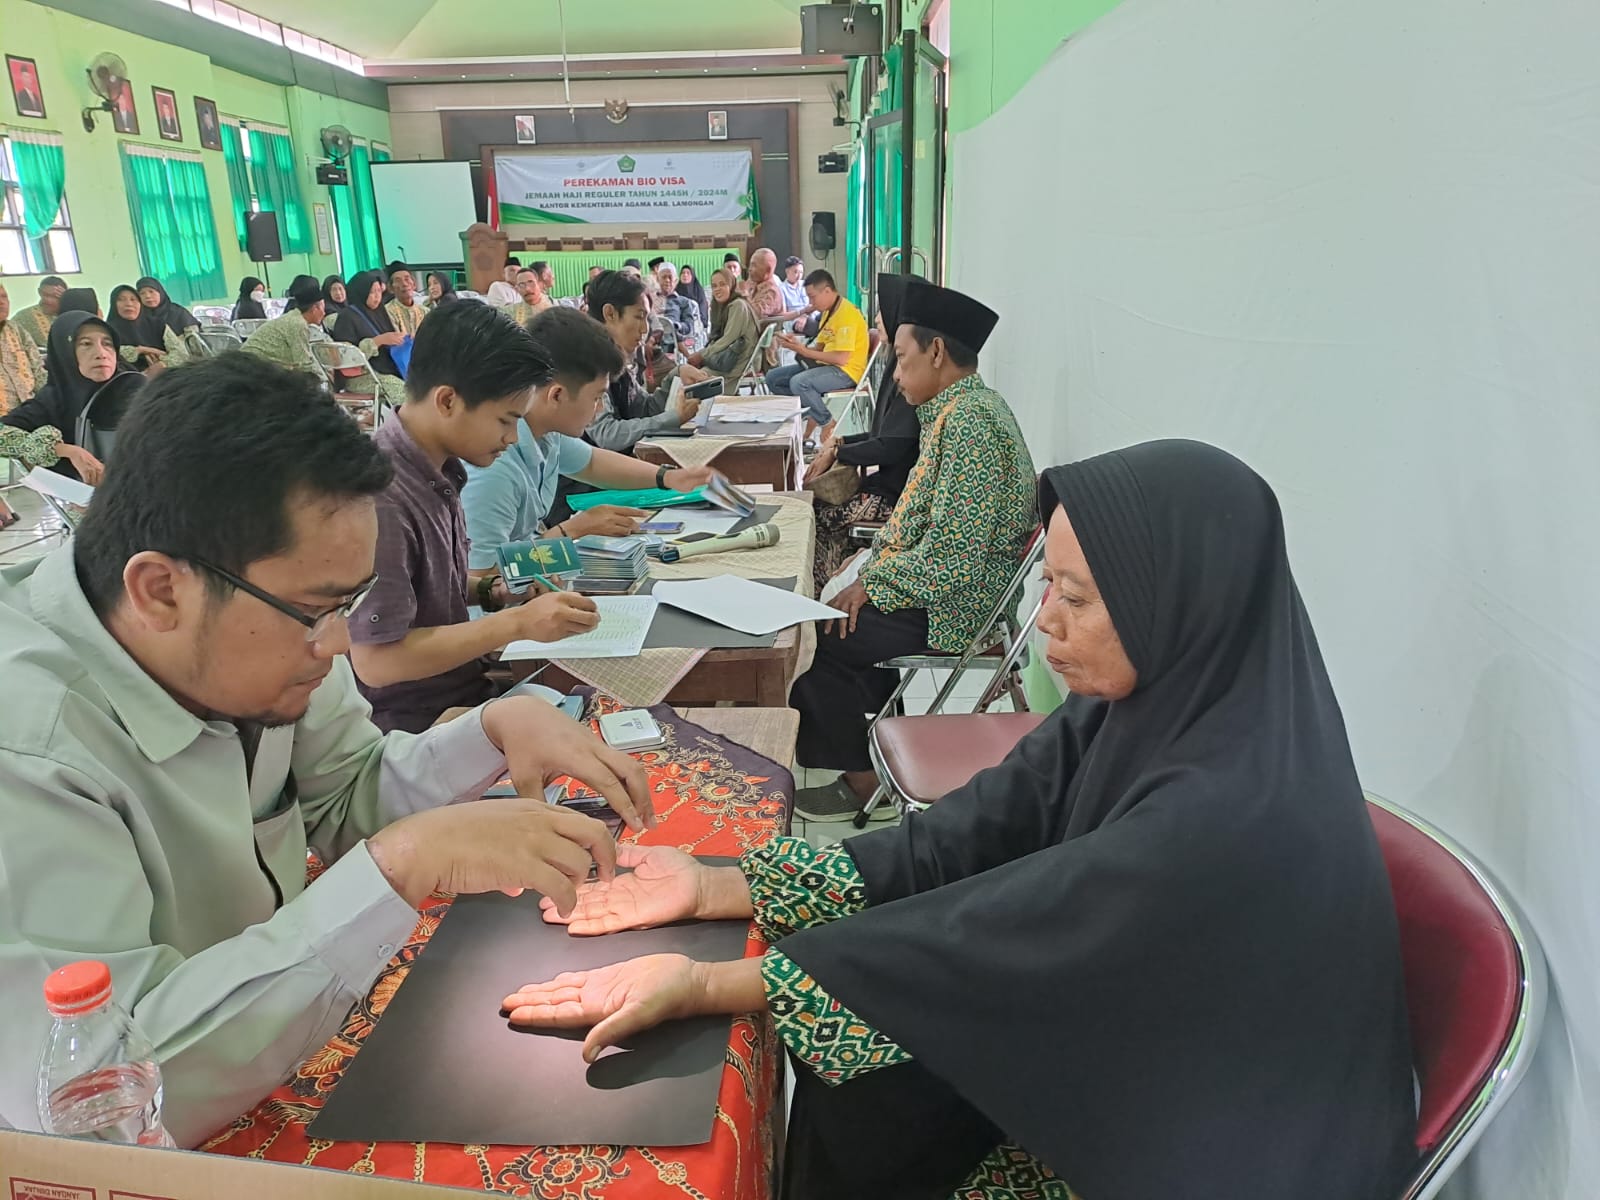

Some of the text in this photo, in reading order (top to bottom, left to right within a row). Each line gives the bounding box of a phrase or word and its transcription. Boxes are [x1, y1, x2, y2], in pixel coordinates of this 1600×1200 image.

[563, 176, 686, 187] PEREKAMAN BIO VISA
[562, 191, 582, 199] HAJI
[660, 189, 688, 197] 1445H
